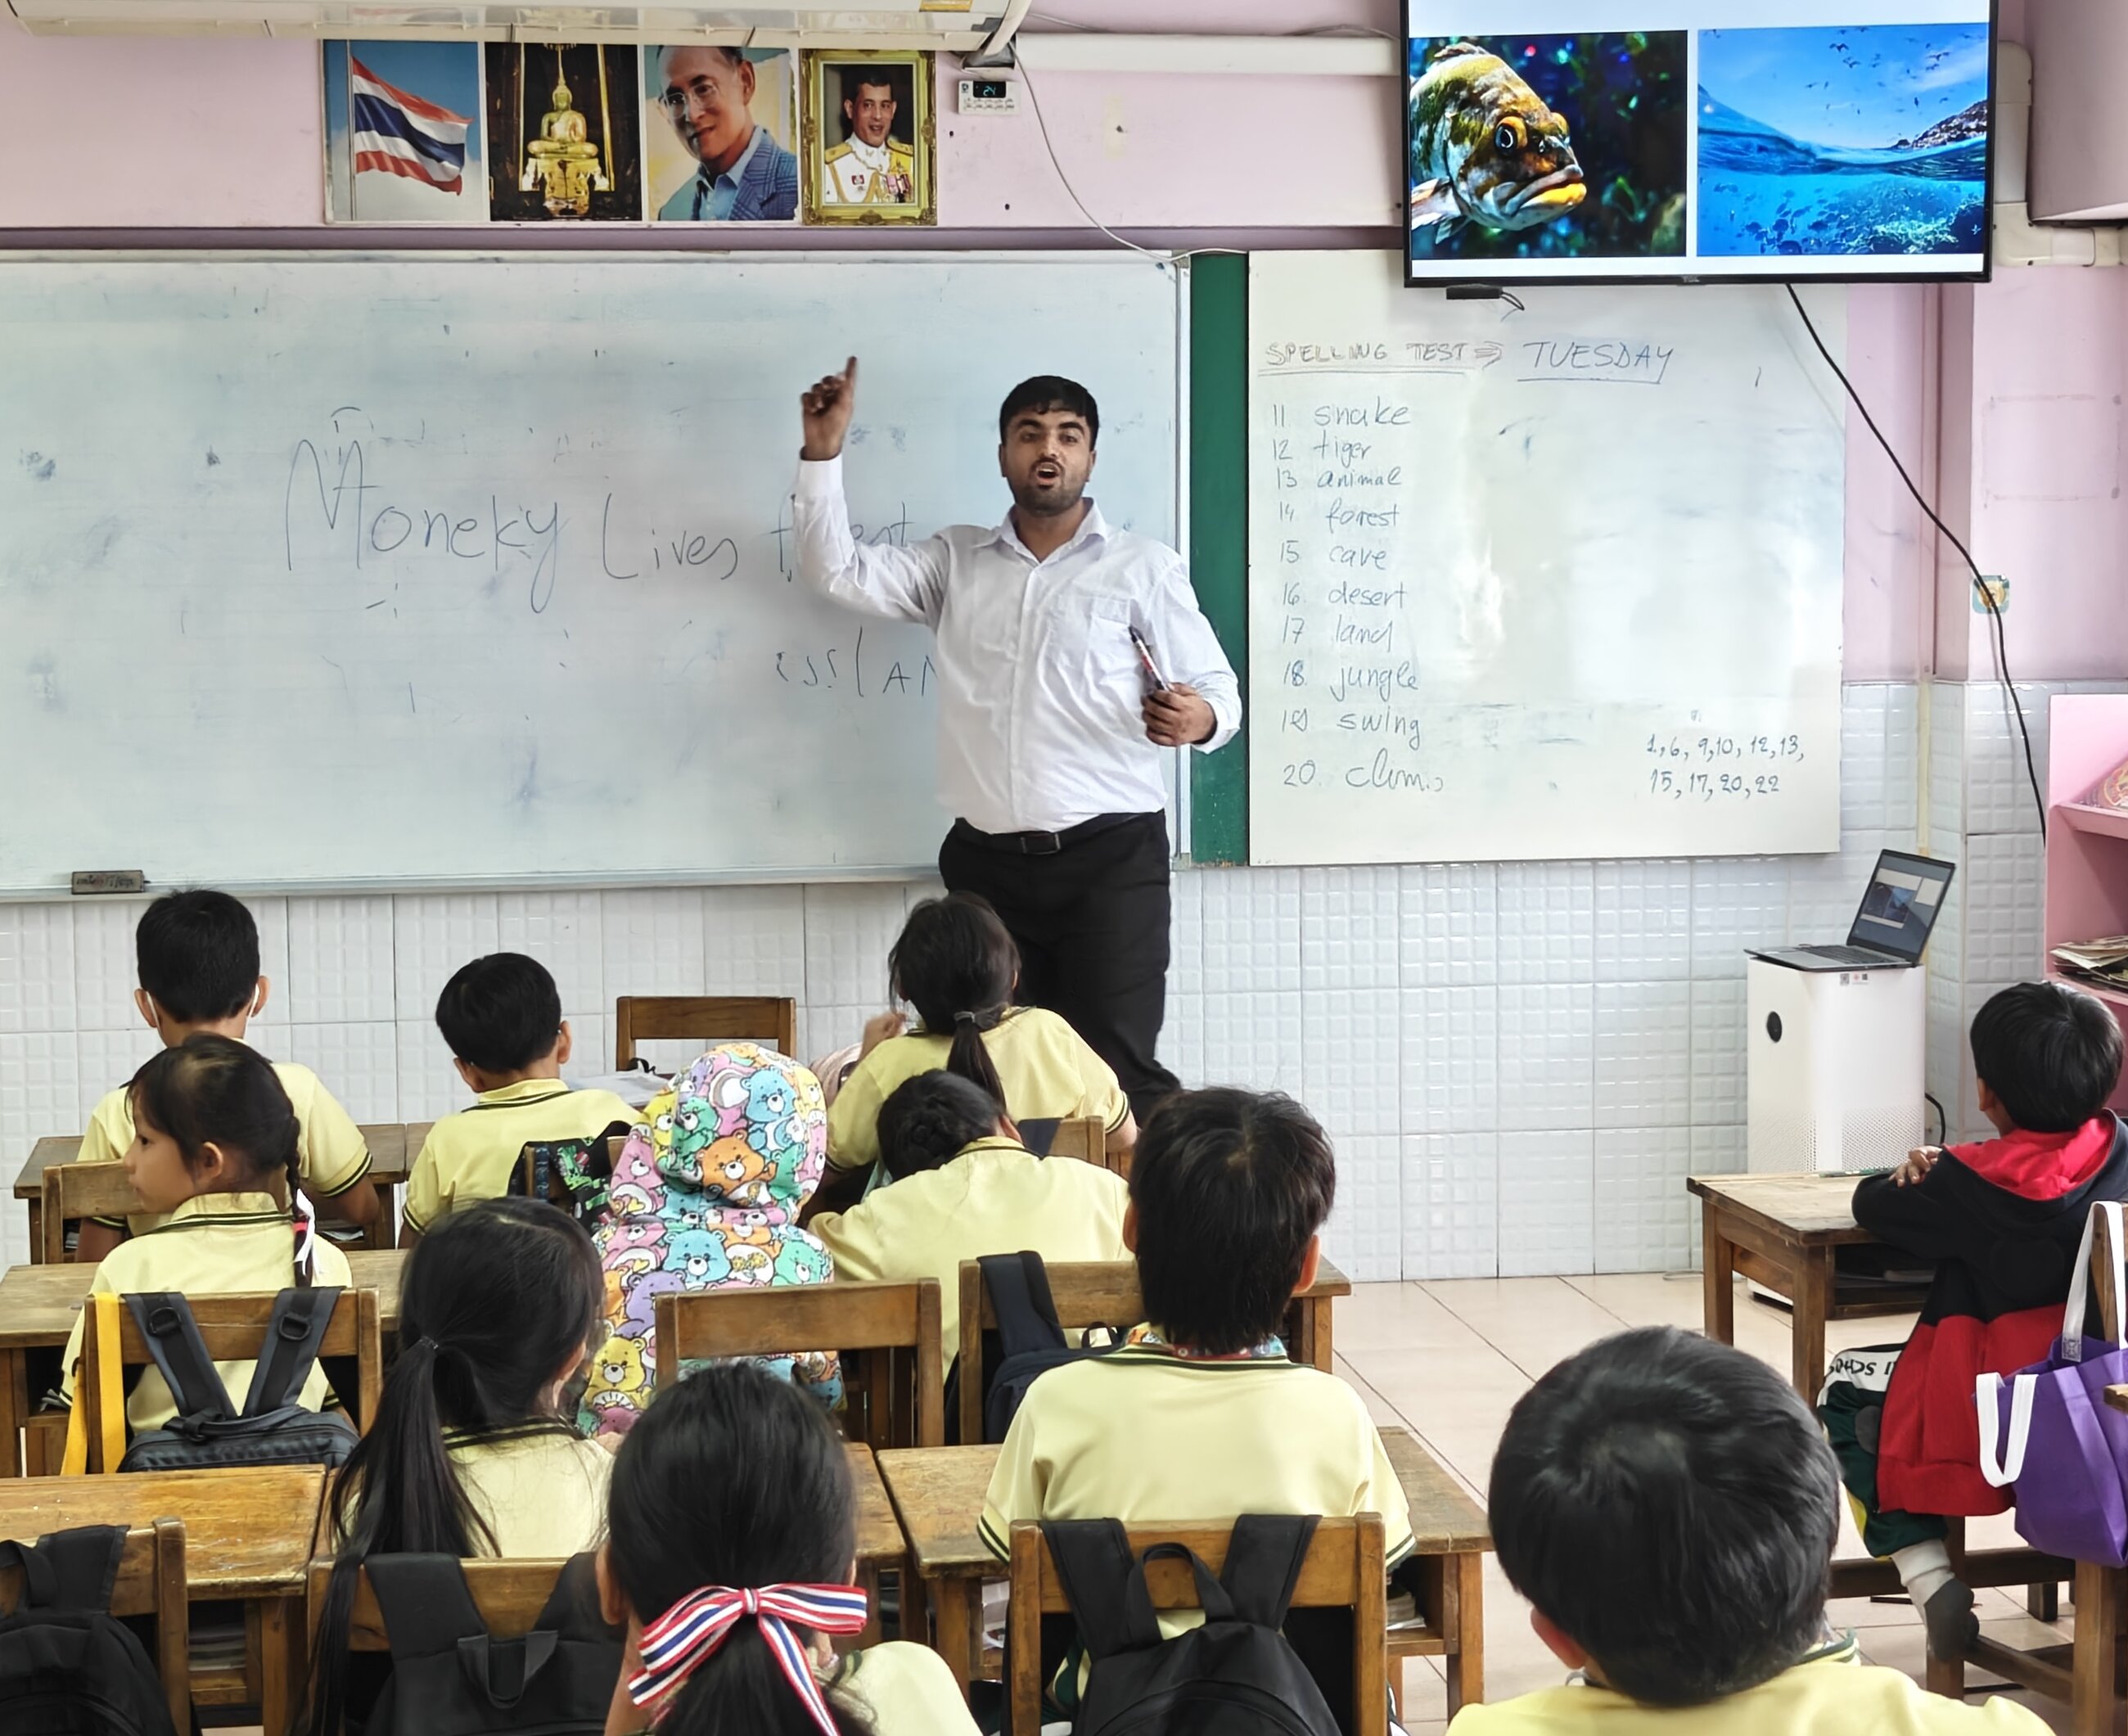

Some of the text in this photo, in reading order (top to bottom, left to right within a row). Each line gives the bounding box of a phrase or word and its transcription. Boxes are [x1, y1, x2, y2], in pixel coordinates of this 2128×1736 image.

[1265, 341, 1469, 366] SPELLING TEST
[1522, 340, 1674, 384] TUESDAY
[1314, 396, 1411, 426] snake
[1273, 430, 1372, 468] 12 tiger
[1277, 466, 1403, 489] 13 animal
[1325, 497, 1400, 534] forest
[1280, 539, 1388, 570] 15 cave
[1328, 580, 1408, 609] desert
[1283, 614, 1394, 652] 17 land
[1329, 661, 1419, 702] jungle
[1336, 705, 1421, 751] swing
